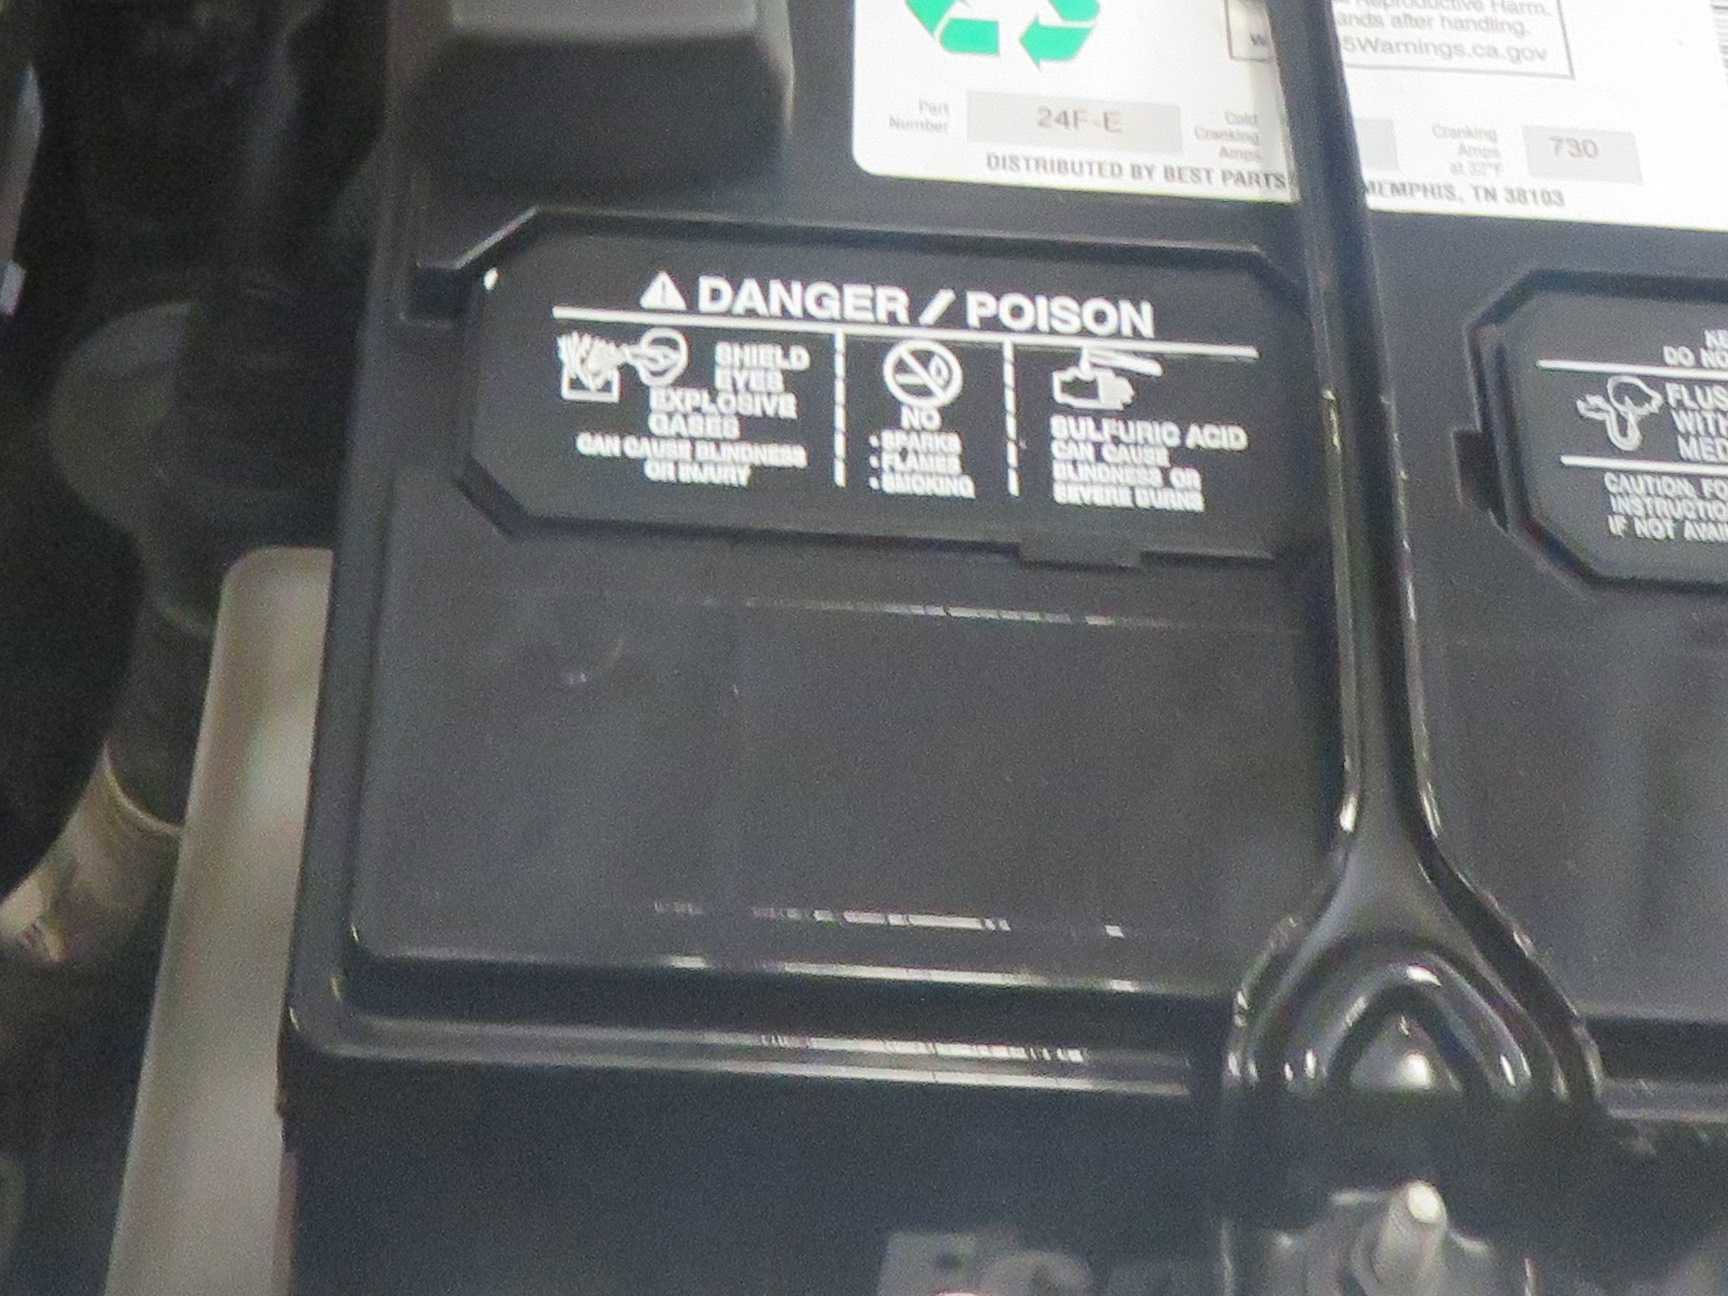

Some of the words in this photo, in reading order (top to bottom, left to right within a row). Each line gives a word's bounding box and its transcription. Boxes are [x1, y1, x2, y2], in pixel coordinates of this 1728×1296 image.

[1336, 13, 1385, 29] ands
[1390, 13, 1434, 30] after
[1441, 13, 1530, 38] handling.
[918, 99, 950, 116] Part
[1036, 105, 1123, 134] 24F-E
[889, 115, 949, 135] Number
[1432, 125, 1498, 143] Cranking
[1548, 136, 1599, 159] 730
[986, 152, 1124, 180] DISTRIBUTED
[1130, 161, 1158, 183] BY
[1163, 162, 1214, 186] BEST
[1472, 185, 1499, 203] TN
[1504, 185, 1565, 207] 38103
[698, 275, 910, 324] DANGER
[966, 290, 1154, 339] POISON
[715, 342, 810, 370] SHIELD
[1663, 345, 1695, 367] DO
[715, 366, 784, 393] EYES
[649, 387, 797, 419] EXPLOSIVE
[648, 412, 739, 439] GASES
[900, 406, 942, 430] NO
[1050, 414, 1180, 448] SULFURIC
[1185, 423, 1248, 451] ACID
[576, 432, 621, 456] CAN
[622, 435, 692, 462] CAUSE
[695, 440, 808, 468] BLINDNESS
[1051, 440, 1095, 463] CAN
[1102, 444, 1171, 468] CAUSE
[1052, 461, 1164, 488] BLINDNESS
[1169, 467, 1201, 491] OR
[1607, 514, 1628, 537] IF
[1633, 516, 1675, 540] NOT
